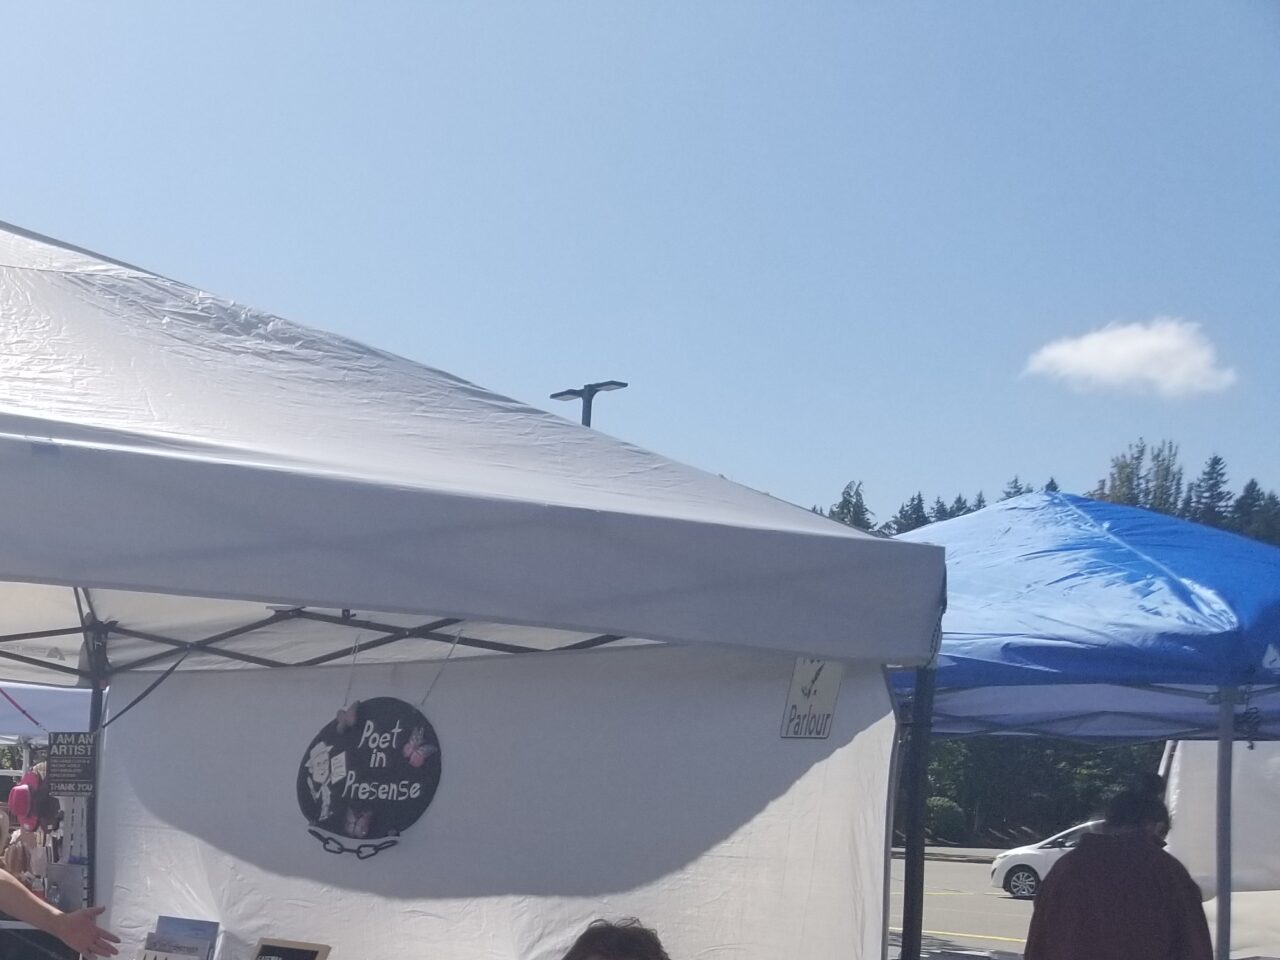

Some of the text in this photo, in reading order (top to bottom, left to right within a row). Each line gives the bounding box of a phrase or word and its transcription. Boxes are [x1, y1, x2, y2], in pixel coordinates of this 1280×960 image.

[785, 703, 831, 737] Parlour
[56, 734, 75, 744] AM
[78, 734, 94, 744] AN
[357, 718, 403, 750] Poet
[50, 744, 93, 755] ARTIST
[369, 749, 387, 768] in
[50, 783, 93, 791] THANK YOU
[341, 770, 421, 801] Presense
